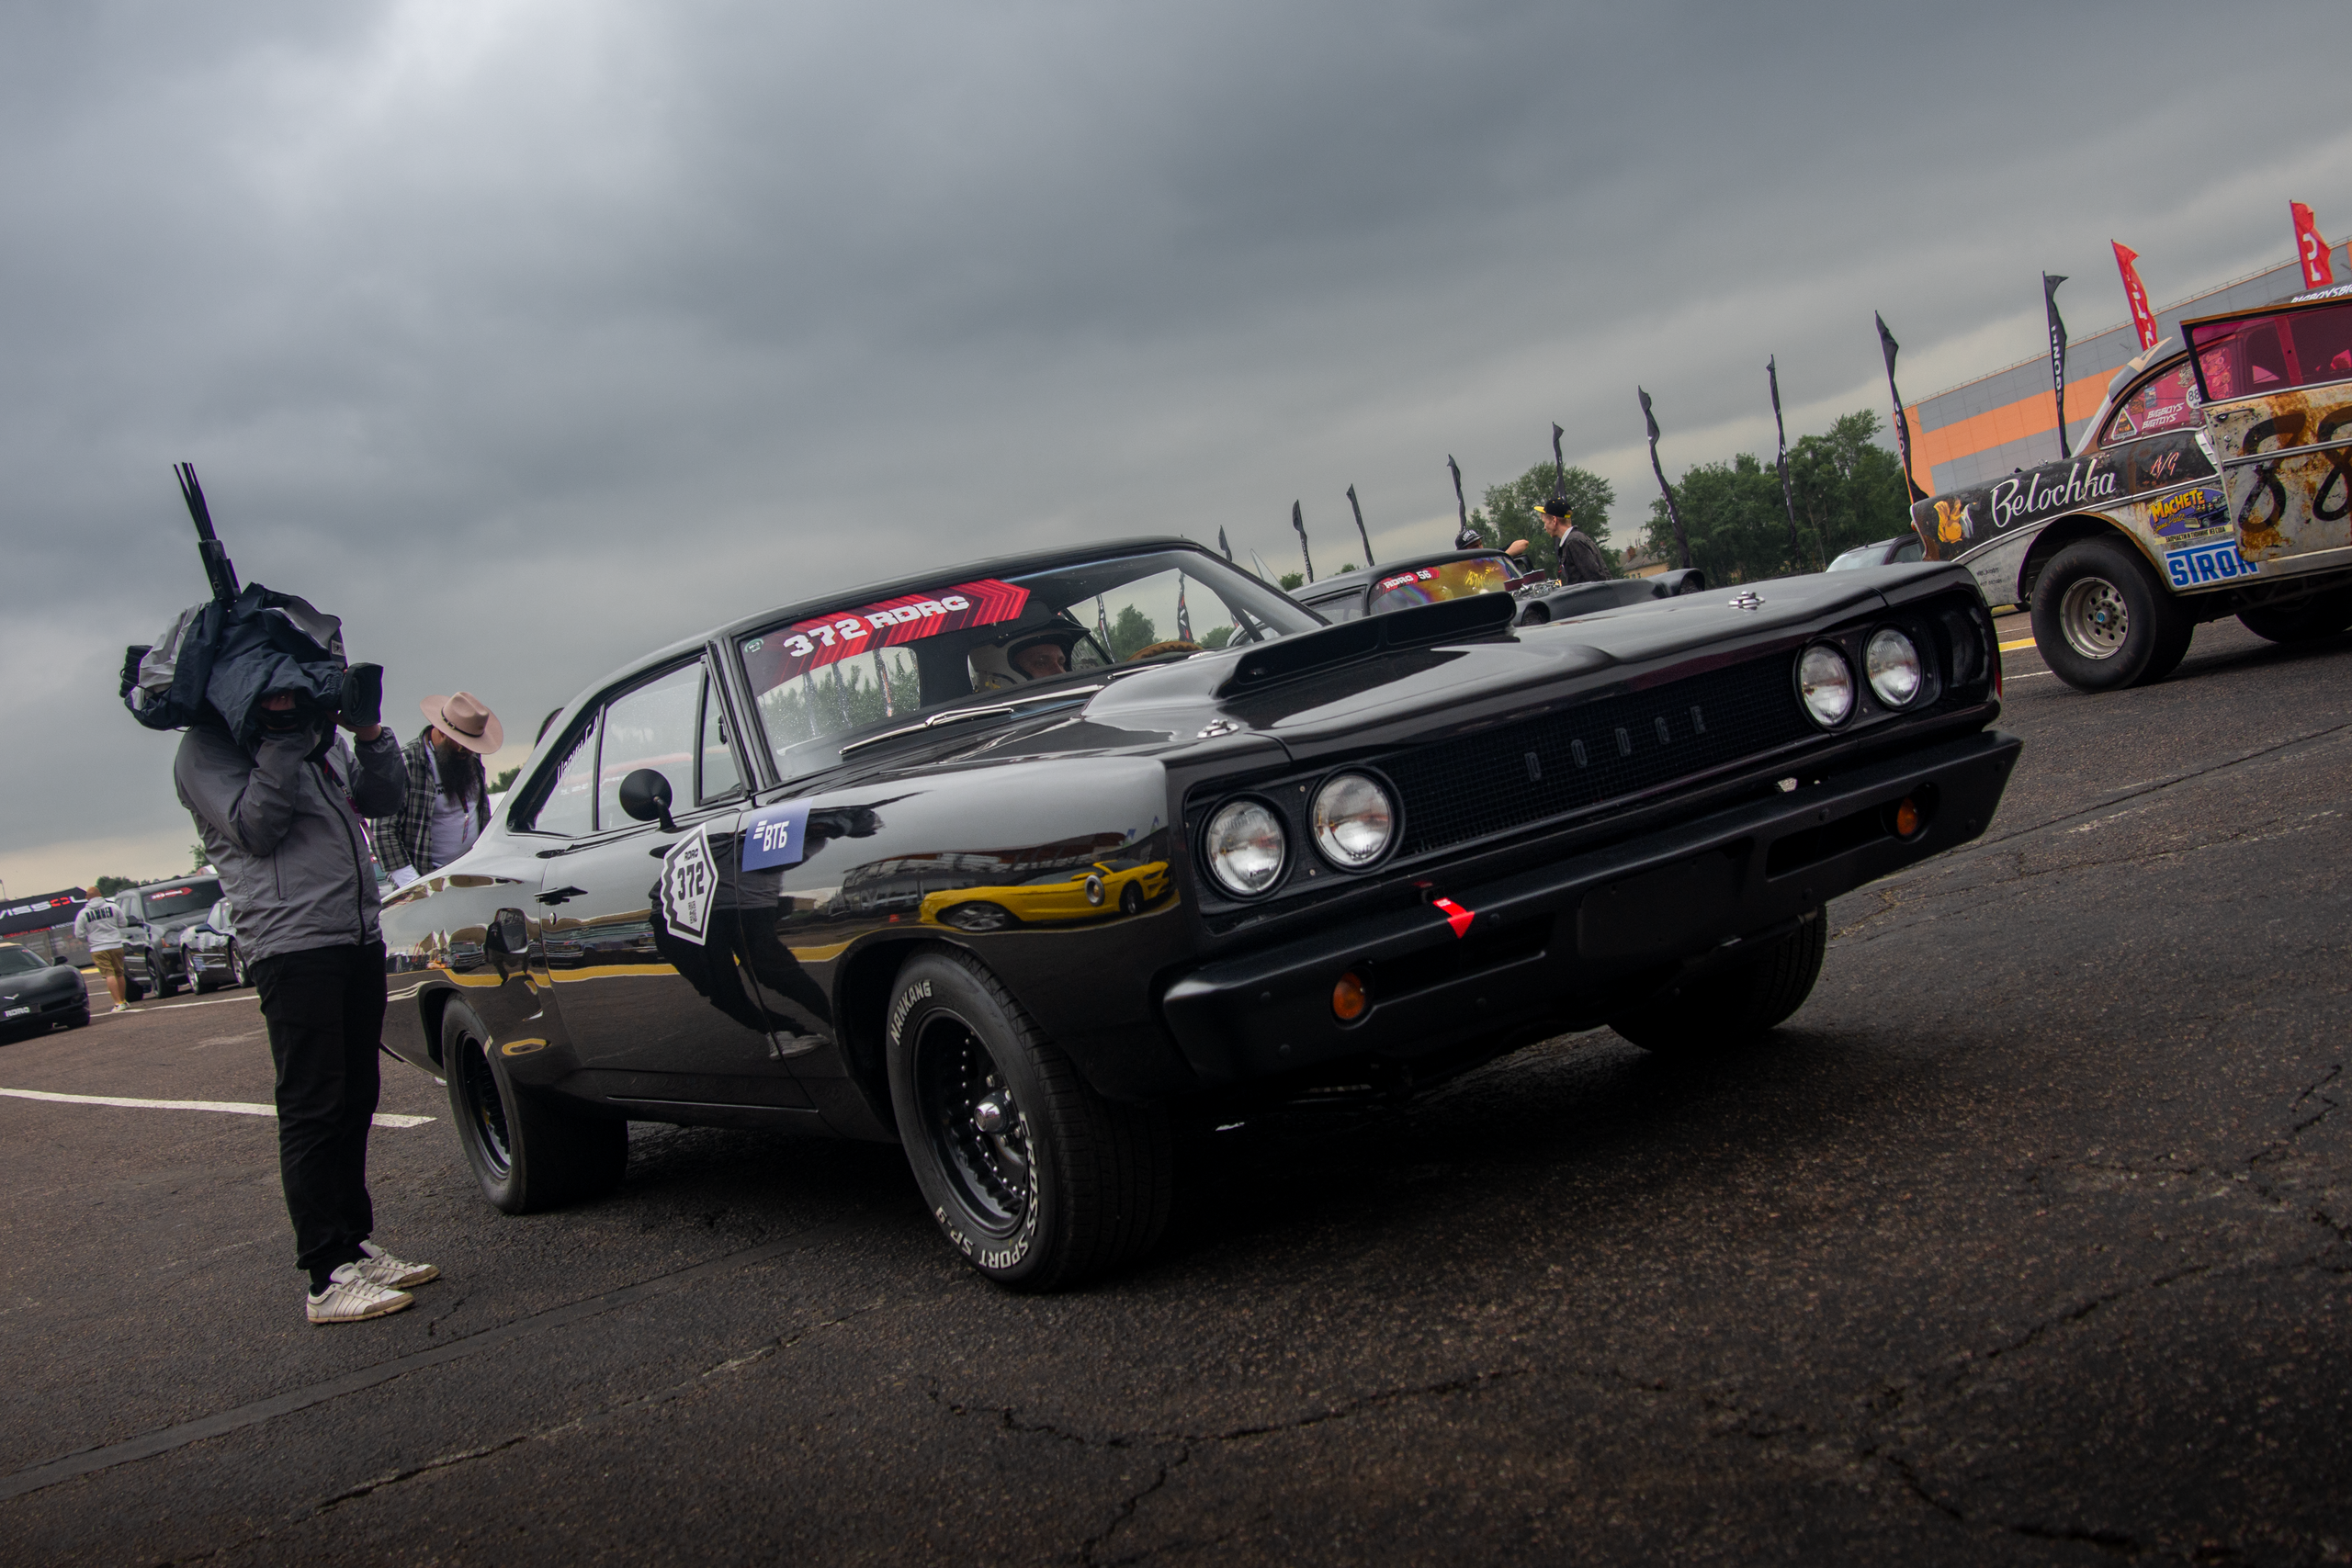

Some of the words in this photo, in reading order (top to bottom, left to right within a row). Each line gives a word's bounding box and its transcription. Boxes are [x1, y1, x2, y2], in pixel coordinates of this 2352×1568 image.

[2142, 412, 2178, 429] BIGTOYS
[2147, 402, 2185, 420] BIGBOYS
[1990, 458, 2116, 528] Belochka
[2150, 489, 2205, 523] MACHETE
[1416, 570, 1432, 580] 56
[783, 618, 868, 658] 372
[865, 595, 970, 630] RDRC
[1524, 705, 1706, 782] DODGE
[763, 820, 790, 852] ВТБ
[677, 861, 705, 901] 372
[889, 980, 933, 1046] NANKANG
[1019, 1111, 1041, 1237] CROSS
[935, 1206, 974, 1257] SP-9
[978, 1235, 1030, 1270] SPORT
